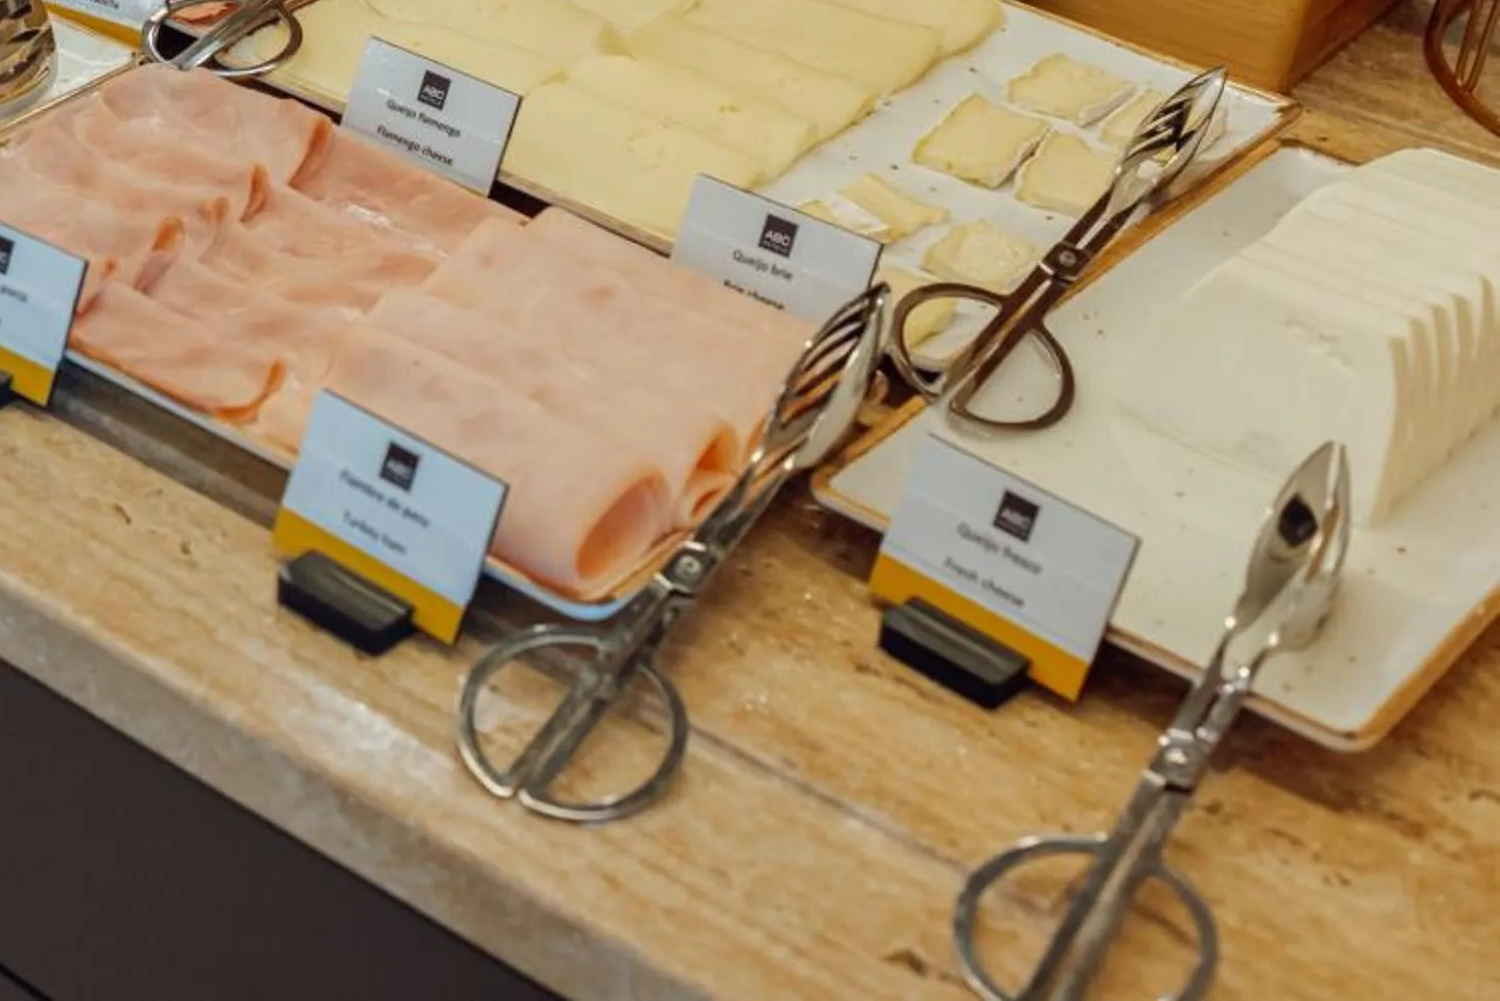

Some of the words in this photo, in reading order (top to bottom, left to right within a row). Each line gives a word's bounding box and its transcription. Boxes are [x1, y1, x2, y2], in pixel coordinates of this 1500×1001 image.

[386, 99, 416, 120] Queijo
[417, 111, 462, 138] flamengo
[376, 124, 421, 152] Flamengo
[422, 143, 454, 166] cheese
[765, 230, 791, 247] ABC
[732, 249, 769, 273] Queijo
[770, 263, 793, 281] brie
[386, 495, 401, 511] de
[1000, 507, 1032, 530] ABC
[956, 521, 1000, 554] Queijo
[1002, 546, 1043, 575] fresco
[944, 555, 980, 583] Fresh
[980, 577, 1026, 608] cheese
